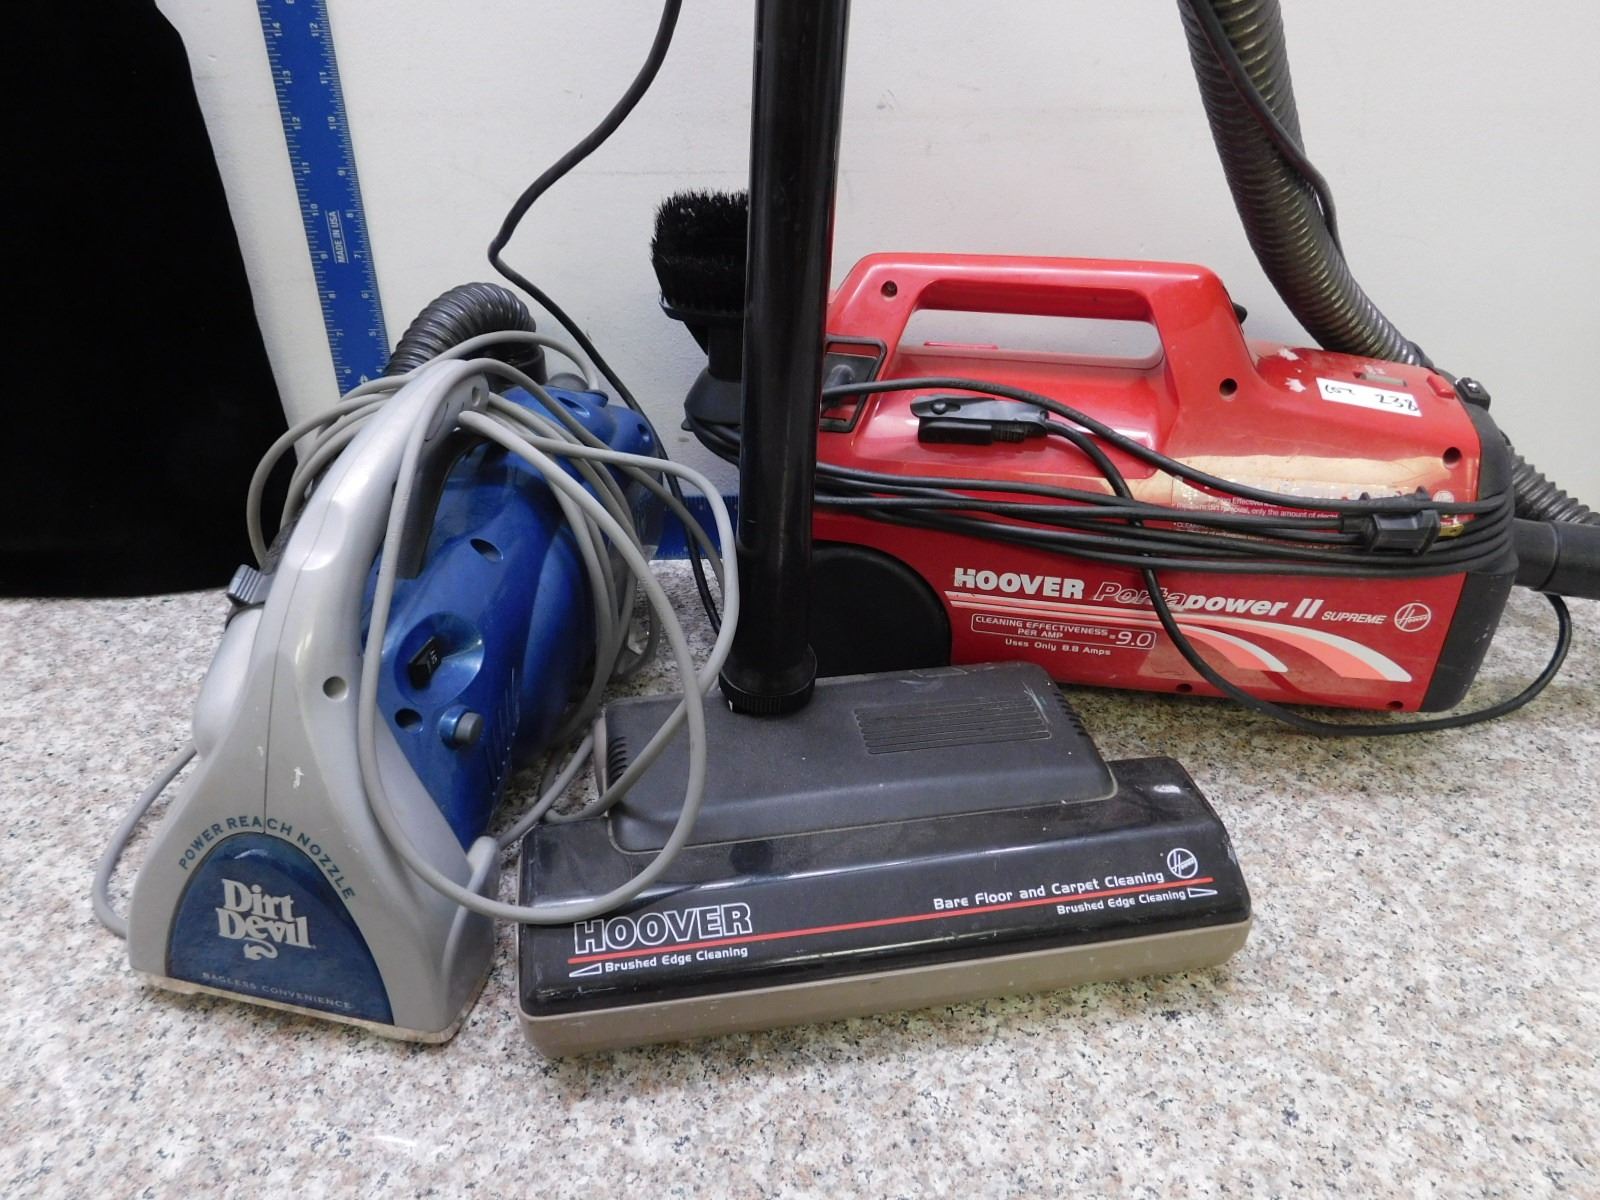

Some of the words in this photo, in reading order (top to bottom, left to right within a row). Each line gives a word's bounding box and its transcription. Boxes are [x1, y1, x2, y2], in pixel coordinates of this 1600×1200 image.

[272, 22, 283, 37] 14
[309, 22, 319, 37] 12
[282, 70, 292, 84] 13
[319, 71, 328, 84] 11
[292, 116, 301, 130] 12
[328, 116, 336, 130] 10
[302, 162, 310, 174] 11
[310, 203, 319, 216] 10
[329, 211, 338, 228] USA
[331, 229, 340, 238] IN
[334, 239, 346, 263] MADE
[1280, 510, 1308, 519] amount
[954, 567, 1085, 600] HOOVER
[1322, 610, 1387, 625] SUPREME
[975, 615, 1023, 628] CLEANING
[1026, 621, 1108, 636] EFFECTIVENESS
[1017, 628, 1036, 637] PER
[1041, 630, 1064, 639] AMP
[1005, 638, 1029, 647] Uses
[1034, 640, 1057, 651] Only
[1062, 644, 1080, 652] 8.8
[1084, 646, 1111, 656] Amps
[178, 823, 223, 870] POWER
[226, 815, 293, 836] REACH
[297, 833, 356, 900] NOZZLE
[933, 895, 969, 910] Bare
[975, 891, 1013, 905] Floor
[1019, 885, 1045, 898] and
[1051, 878, 1100, 895] Carpet
[1105, 871, 1165, 888] Cleaning
[222, 878, 295, 922] Dirt
[1056, 902, 1104, 915] Brushed
[1108, 897, 1136, 909] Edge
[1138, 889, 1186, 903] Cleaning
[215, 907, 313, 949] Devil
[574, 902, 752, 955] HOOVER
[605, 957, 657, 973] Brushed
[661, 954, 692, 967] Edge
[696, 947, 748, 961] Cleaning
[262, 985, 354, 1010] CONVENIENCE
